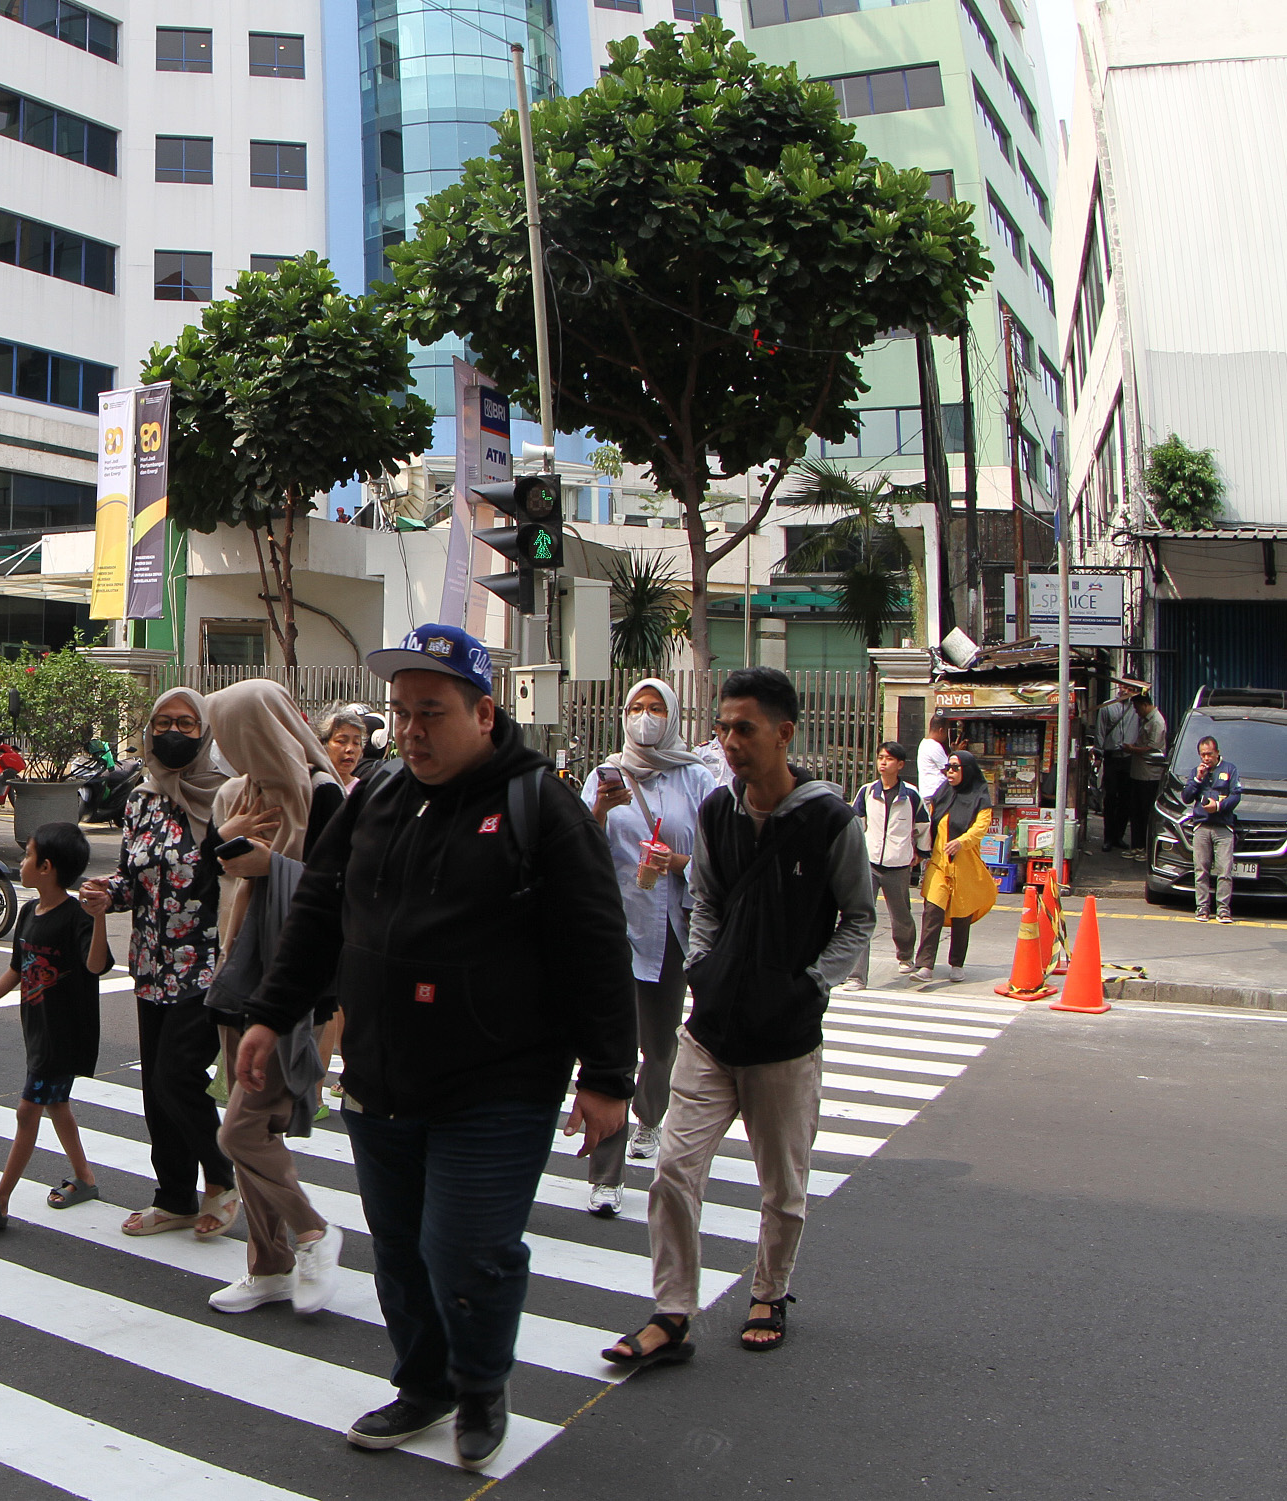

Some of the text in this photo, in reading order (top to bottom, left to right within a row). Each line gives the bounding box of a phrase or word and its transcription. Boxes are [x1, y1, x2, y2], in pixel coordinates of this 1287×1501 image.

[492, 402, 506, 422] BRI
[105, 426, 124, 456] 80
[140, 422, 161, 453] 80
[486, 446, 506, 466] ATM
[936, 694, 971, 705] BARU
[1243, 864, 1256, 872] TIB
